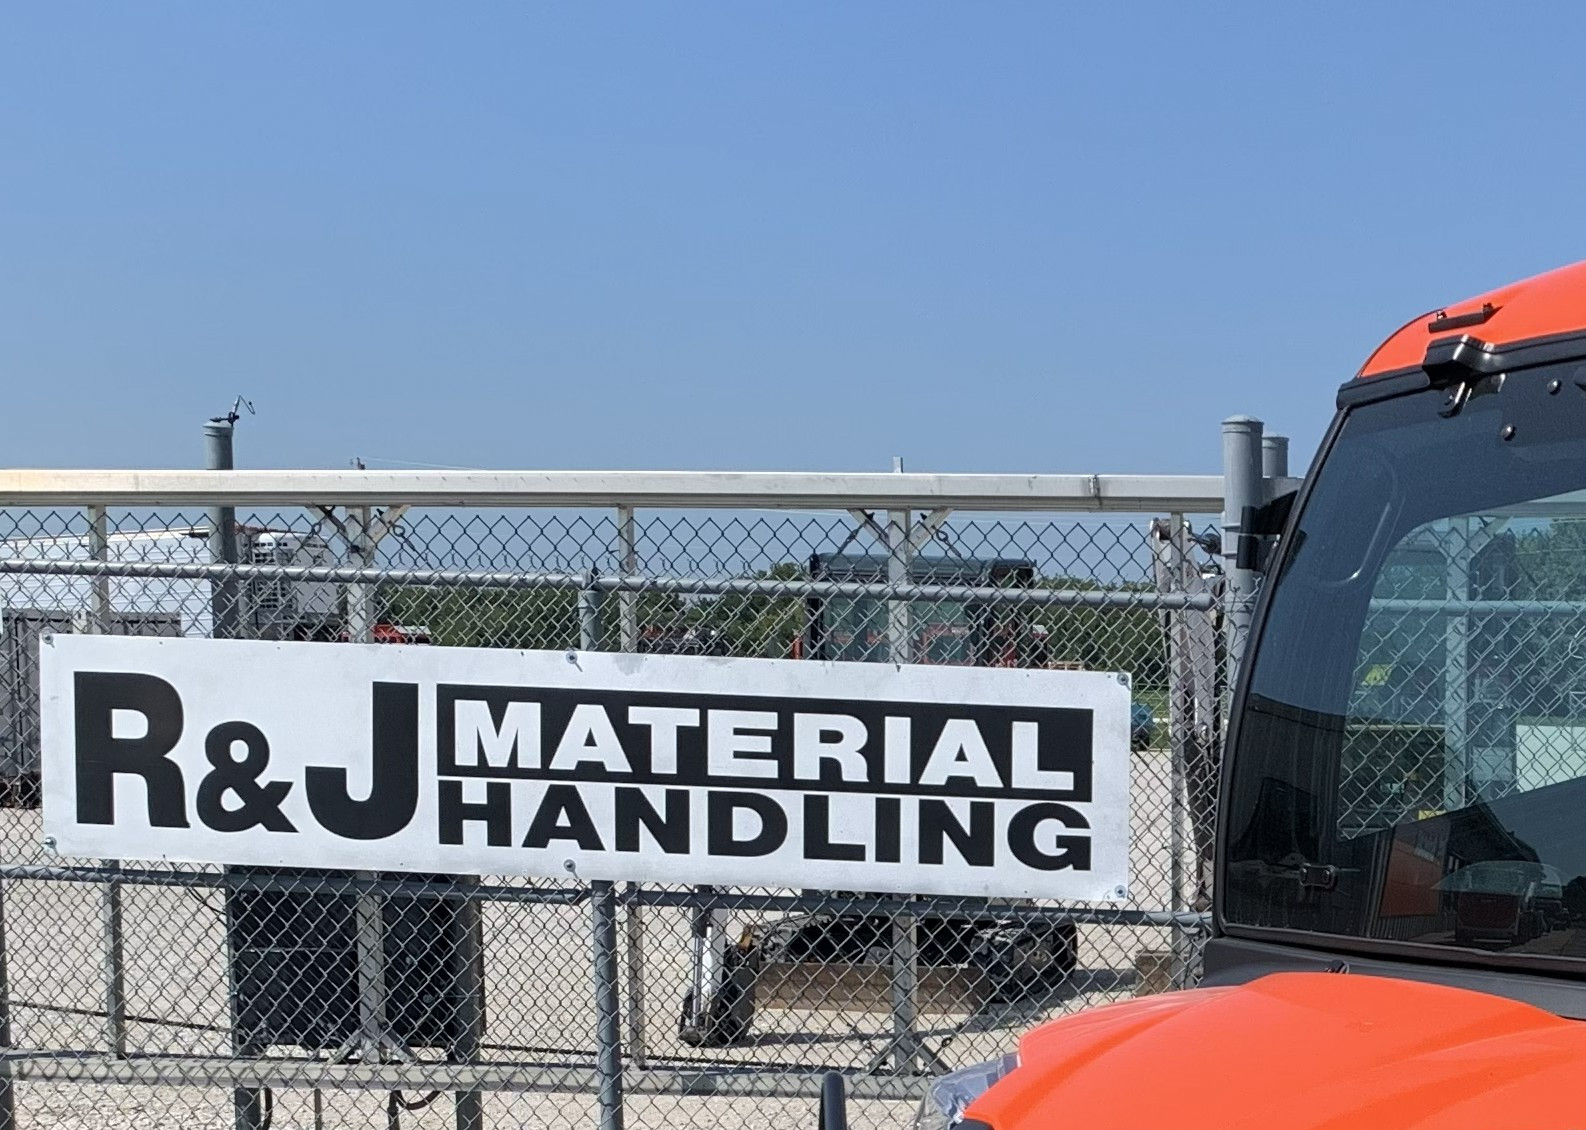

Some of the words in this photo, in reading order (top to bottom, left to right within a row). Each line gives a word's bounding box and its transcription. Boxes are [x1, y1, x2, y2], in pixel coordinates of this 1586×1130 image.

[74, 671, 419, 841] R&J
[454, 699, 1074, 791] MATERIAL
[438, 779, 1092, 871] HANDLING
